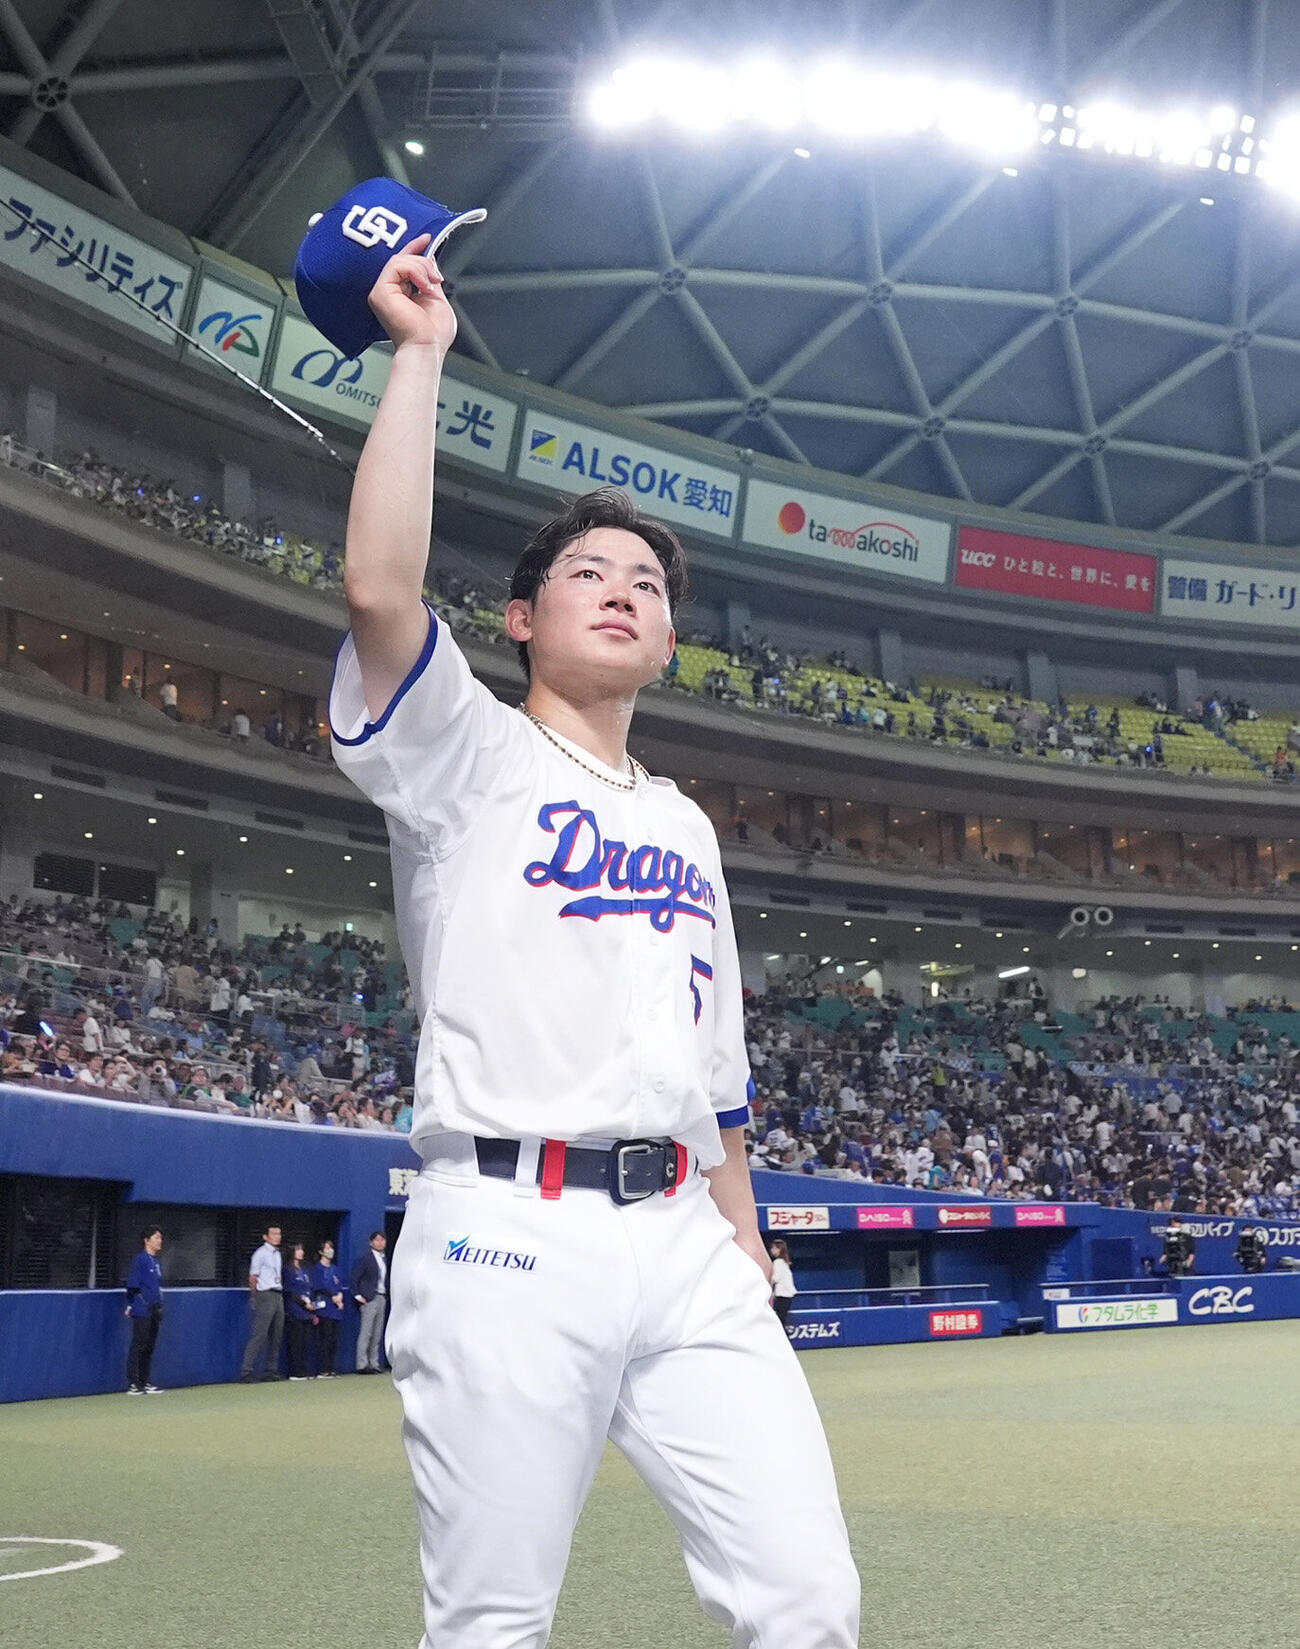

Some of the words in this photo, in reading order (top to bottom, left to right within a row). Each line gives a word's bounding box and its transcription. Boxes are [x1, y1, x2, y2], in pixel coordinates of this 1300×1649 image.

[437, 400, 495, 450] 光
[808, 519, 919, 562] tamakoshi
[523, 800, 716, 933] Dragon
[443, 1235, 537, 1271] MEITETSU
[1092, 1303, 1158, 1322] フタムラ化学
[1188, 1286, 1254, 1315] CBC
